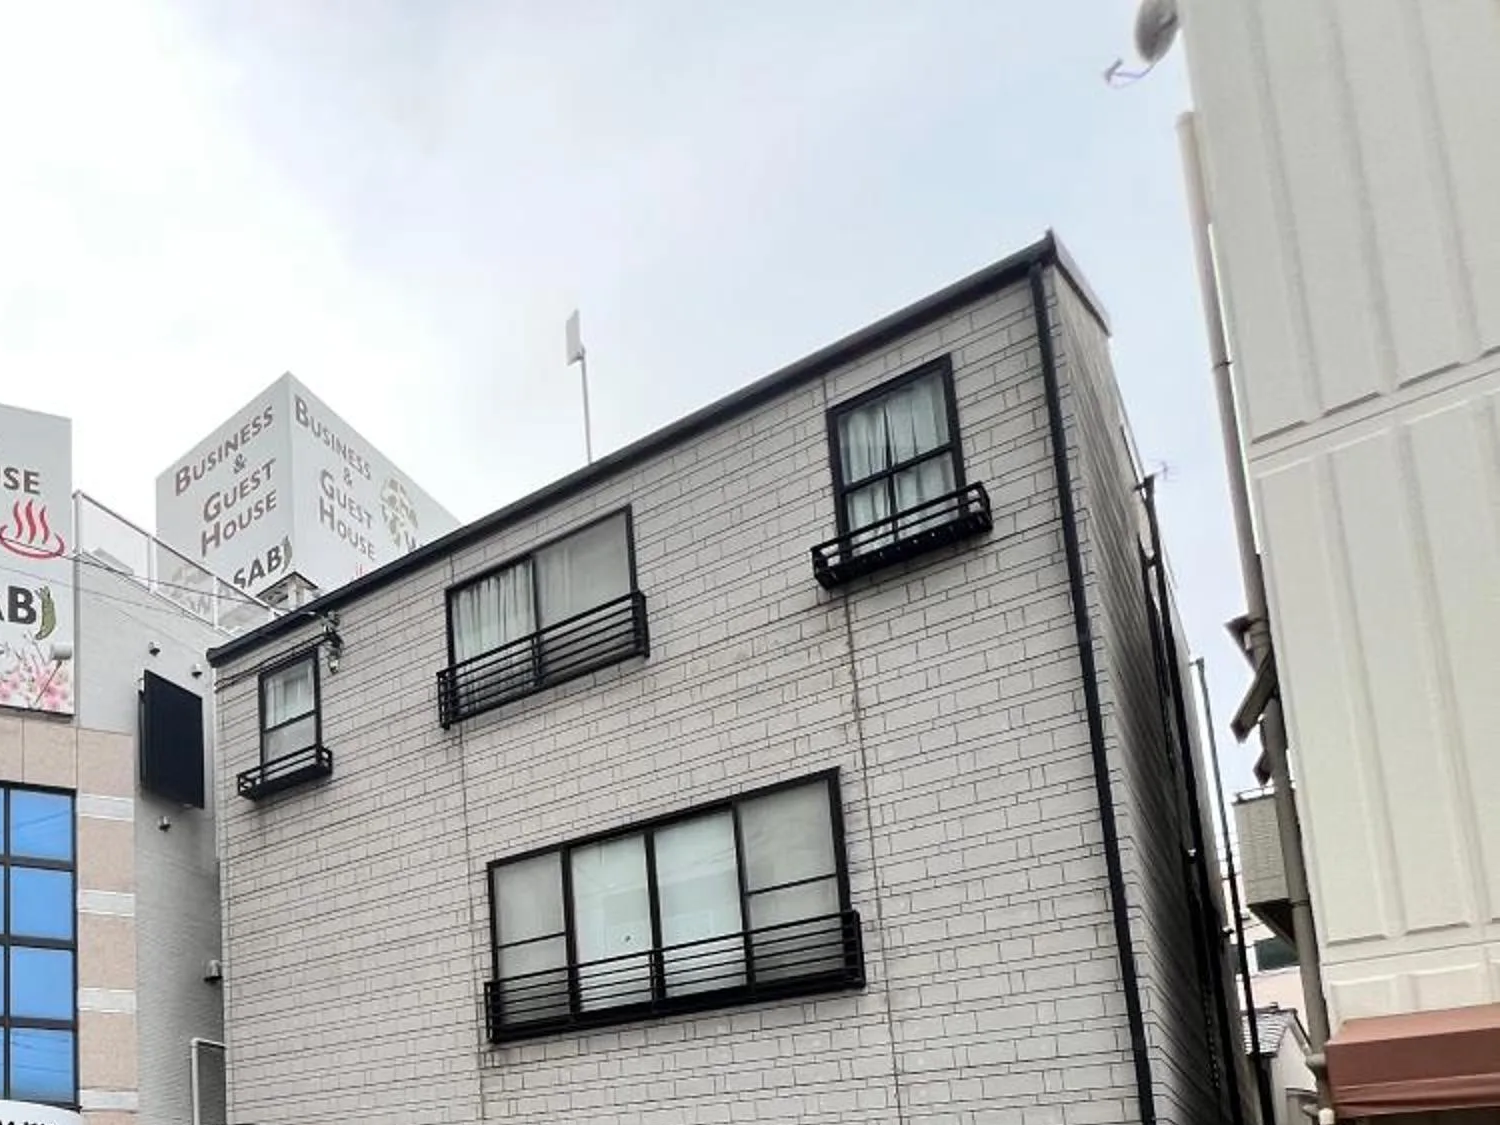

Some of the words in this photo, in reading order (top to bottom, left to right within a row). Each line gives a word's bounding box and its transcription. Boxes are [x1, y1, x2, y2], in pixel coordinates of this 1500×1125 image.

[175, 406, 273, 496] BUSINESS
[233, 453, 246, 474] &
[294, 394, 371, 480] BUSINESS
[201, 489, 277, 557] HOUSE
[203, 458, 276, 522] GUEST
[321, 469, 373, 529] GUEST
[319, 496, 376, 562] HOUSE
